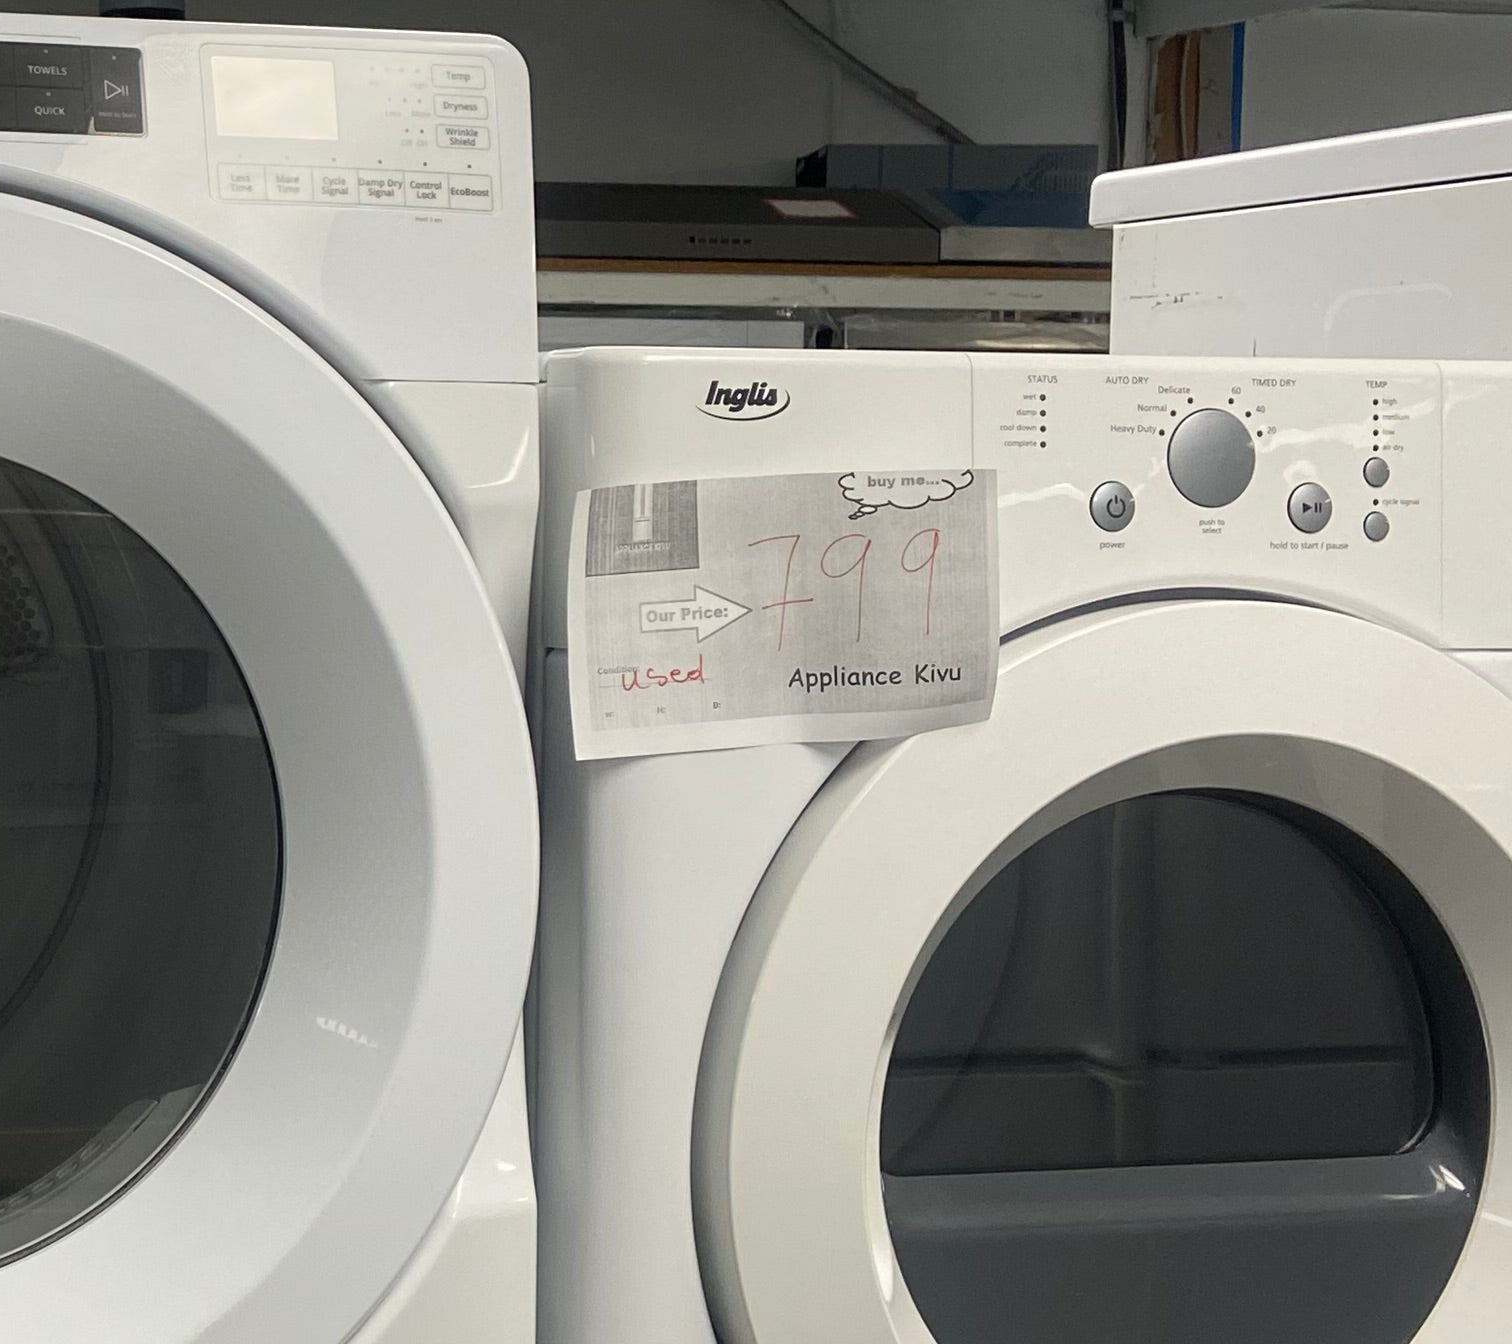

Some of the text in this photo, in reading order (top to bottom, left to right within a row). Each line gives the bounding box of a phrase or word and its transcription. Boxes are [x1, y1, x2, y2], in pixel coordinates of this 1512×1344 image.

[27, 65, 68, 76] TOWELS
[446, 72, 471, 83] Temp
[34, 106, 65, 116] QUICK
[443, 101, 478, 113] Dryness
[445, 128, 478, 137] Wrinkle
[449, 137, 477, 146] Shield
[322, 176, 347, 187] Cycle
[358, 178, 404, 190] Damp Dry
[409, 181, 442, 191] Control
[321, 185, 349, 197] Signal
[368, 188, 395, 198] Signal
[416, 190, 437, 200] Lock
[450, 187, 489, 198] EcoBoost
[1027, 375, 1059, 384] STATUS
[1105, 376, 1149, 385] AUTO DRY
[1252, 378, 1296, 388] TIMED DRY
[1366, 380, 1388, 389] TEMP
[1157, 385, 1191, 395] Delicate
[1231, 387, 1242, 395] 60
[705, 380, 778, 412] Inglis
[1137, 404, 1168, 413] Normal
[1110, 424, 1157, 435] Heavy Duty
[1266, 426, 1277, 435] 20
[867, 476, 896, 489] buy
[1099, 541, 1125, 550] power
[748, 528, 940, 651] 799
[646, 606, 729, 623] Our Price:
[788, 664, 962, 693] Appliance Kivu
